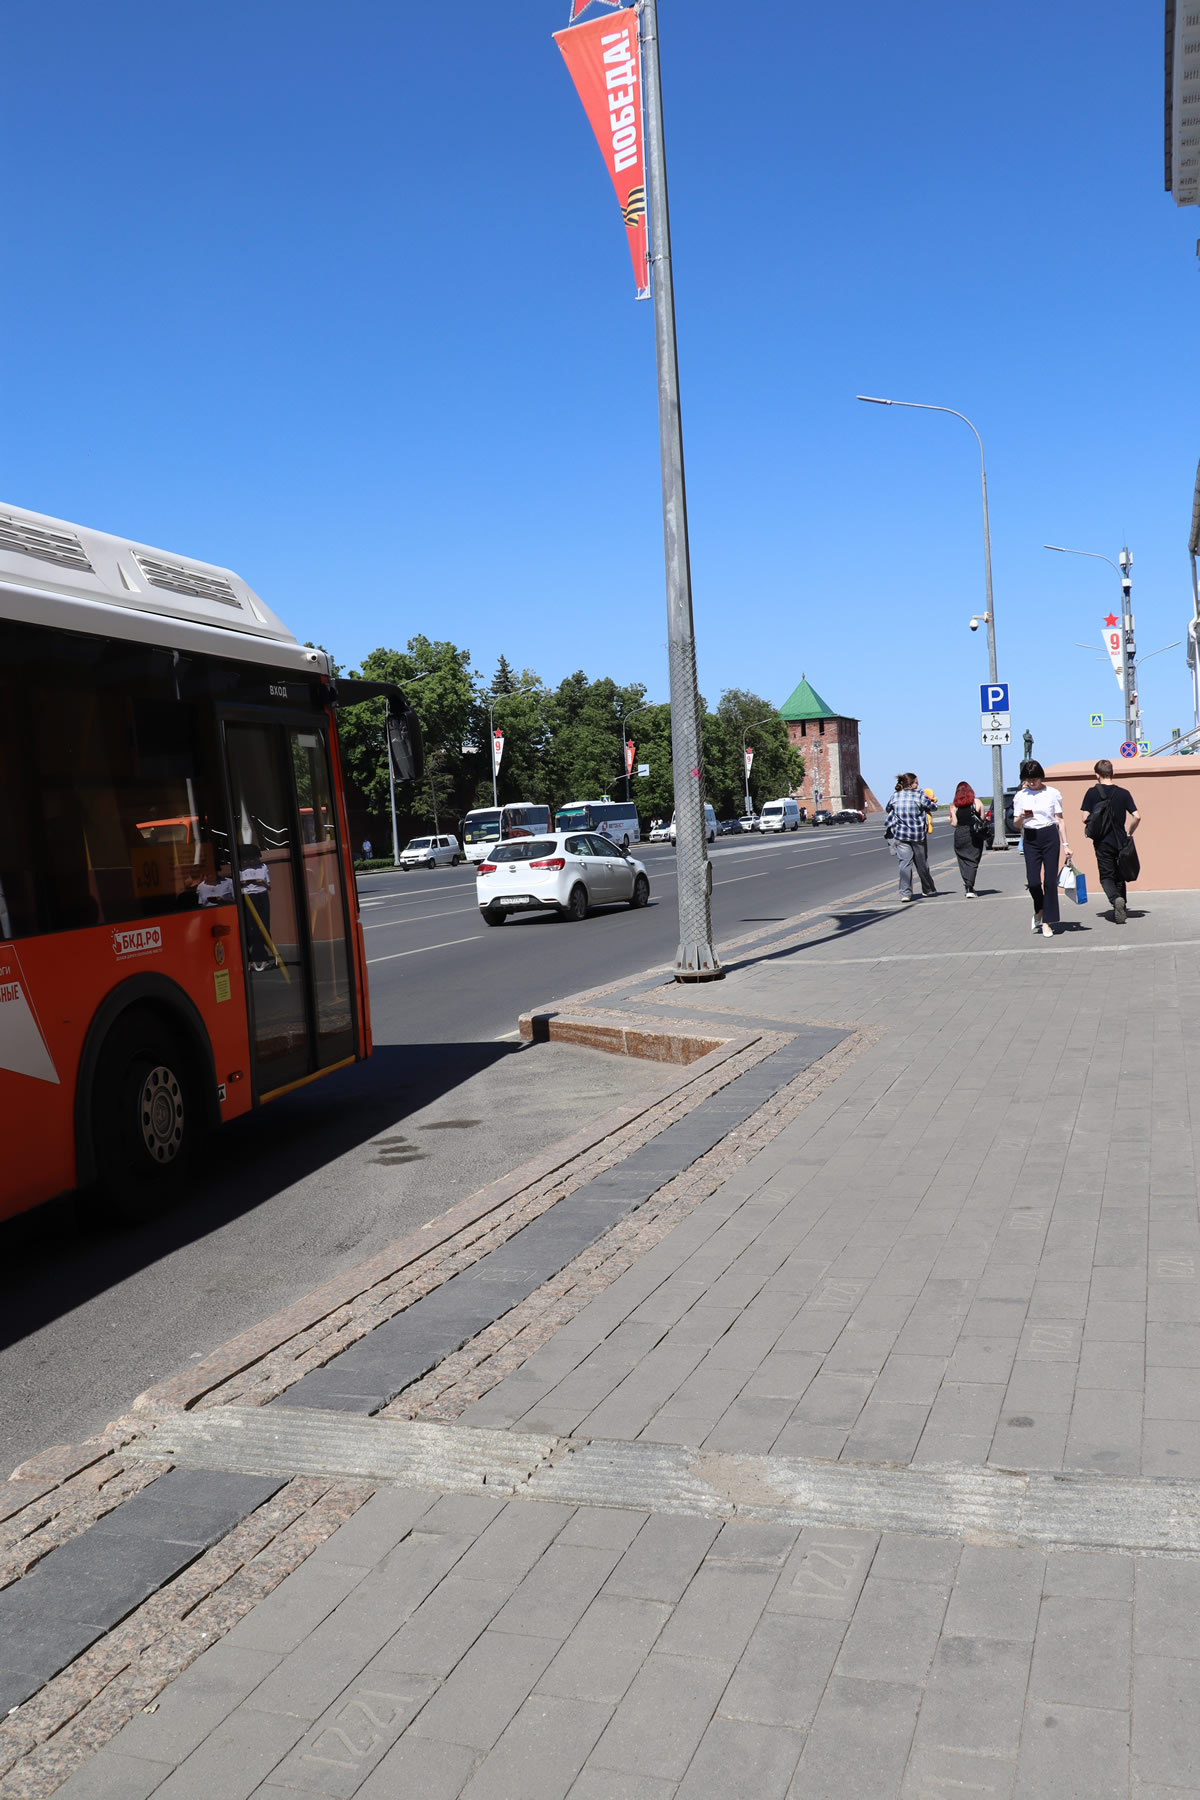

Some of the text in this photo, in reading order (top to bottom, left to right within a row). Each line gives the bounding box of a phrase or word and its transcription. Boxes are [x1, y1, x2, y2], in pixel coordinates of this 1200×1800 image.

[600, 28, 638, 173] ПОБЕДА!
[1110, 633, 1120, 650] 9
[269, 684, 288, 699] ВХОД
[987, 686, 1004, 710] P
[495, 740, 501, 751] 9
[122, 929, 160, 950] БКД.РФ
[0, 984, 19, 1003] НЫЕ
[787, 1541, 864, 1600] 1221
[299, 1689, 414, 1769] 1221
